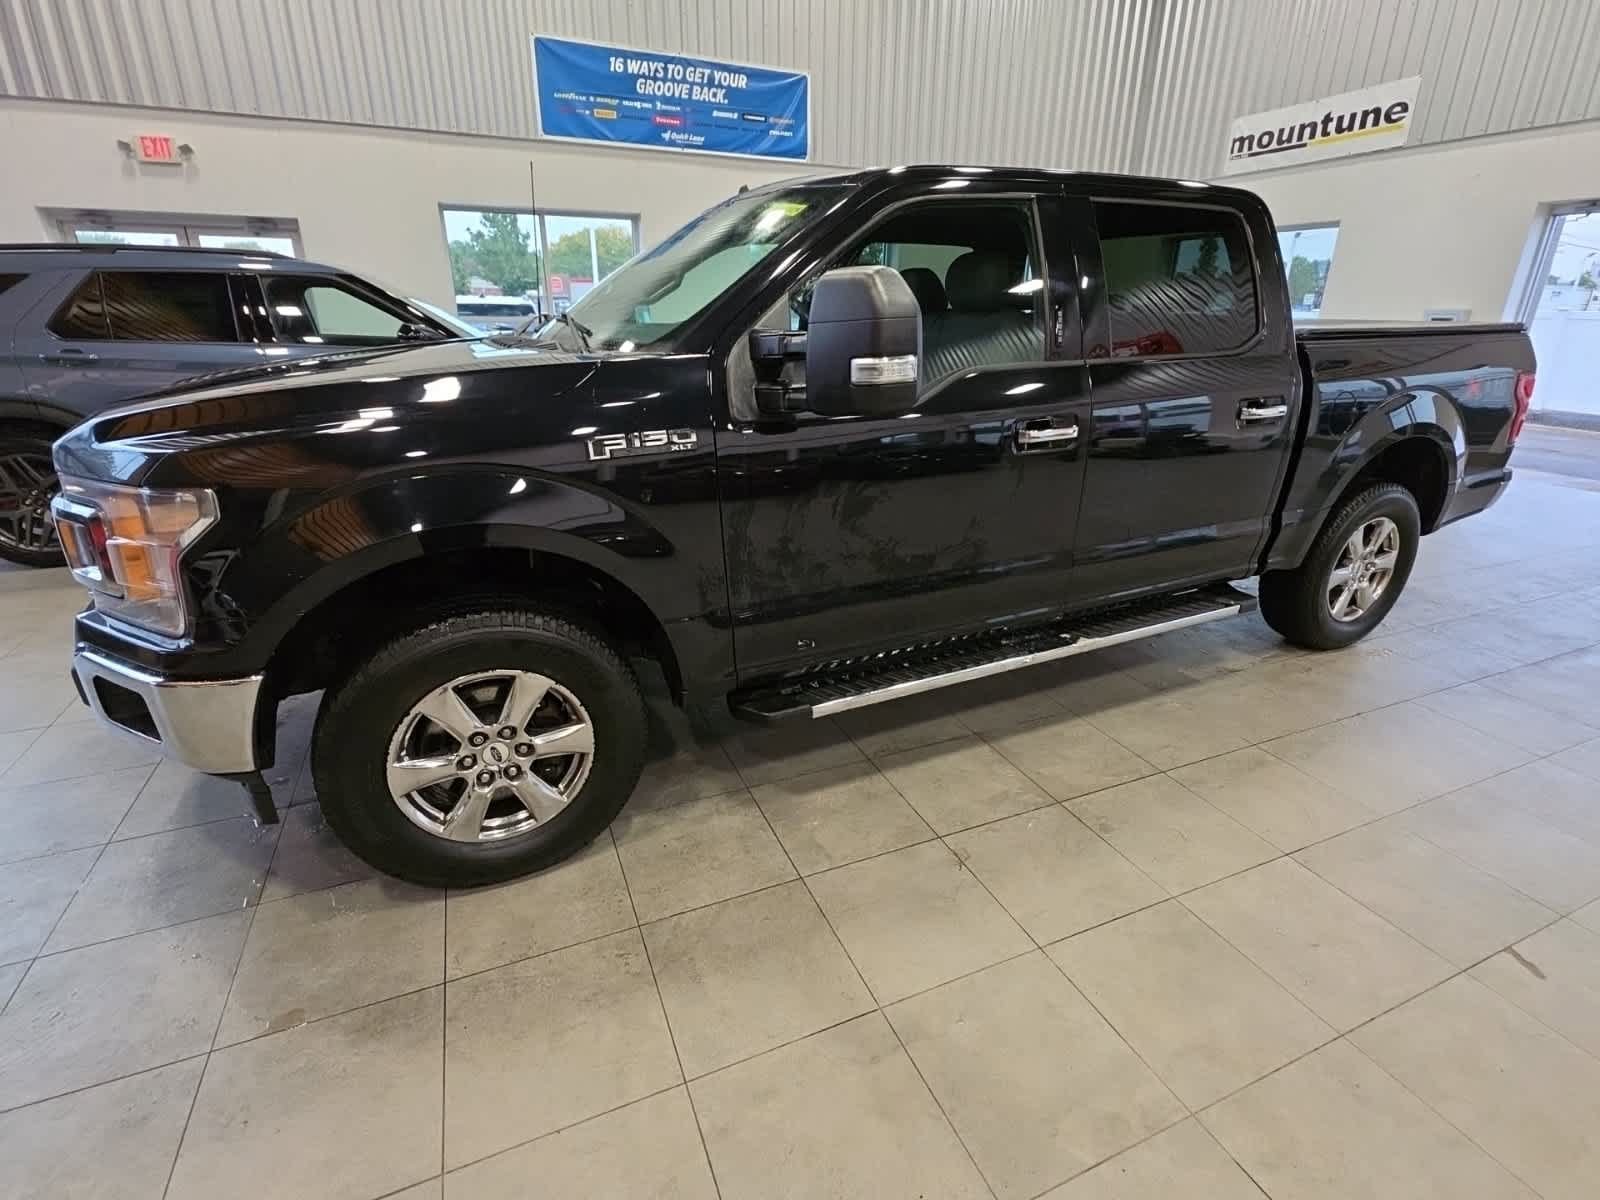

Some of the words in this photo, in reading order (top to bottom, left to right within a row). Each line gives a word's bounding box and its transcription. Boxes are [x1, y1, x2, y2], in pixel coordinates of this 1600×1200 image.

[609, 57, 624, 73] 16
[627, 59, 665, 78] WAYS
[667, 63, 683, 79] TO
[686, 66, 711, 84] GET
[714, 70, 747, 88] YOUR
[636, 78, 690, 99] GROOVE
[692, 85, 729, 104] BACK.
[1230, 101, 1409, 155] mountune
[139, 136, 171, 159] EXIT
[671, 443, 693, 451] XLT
